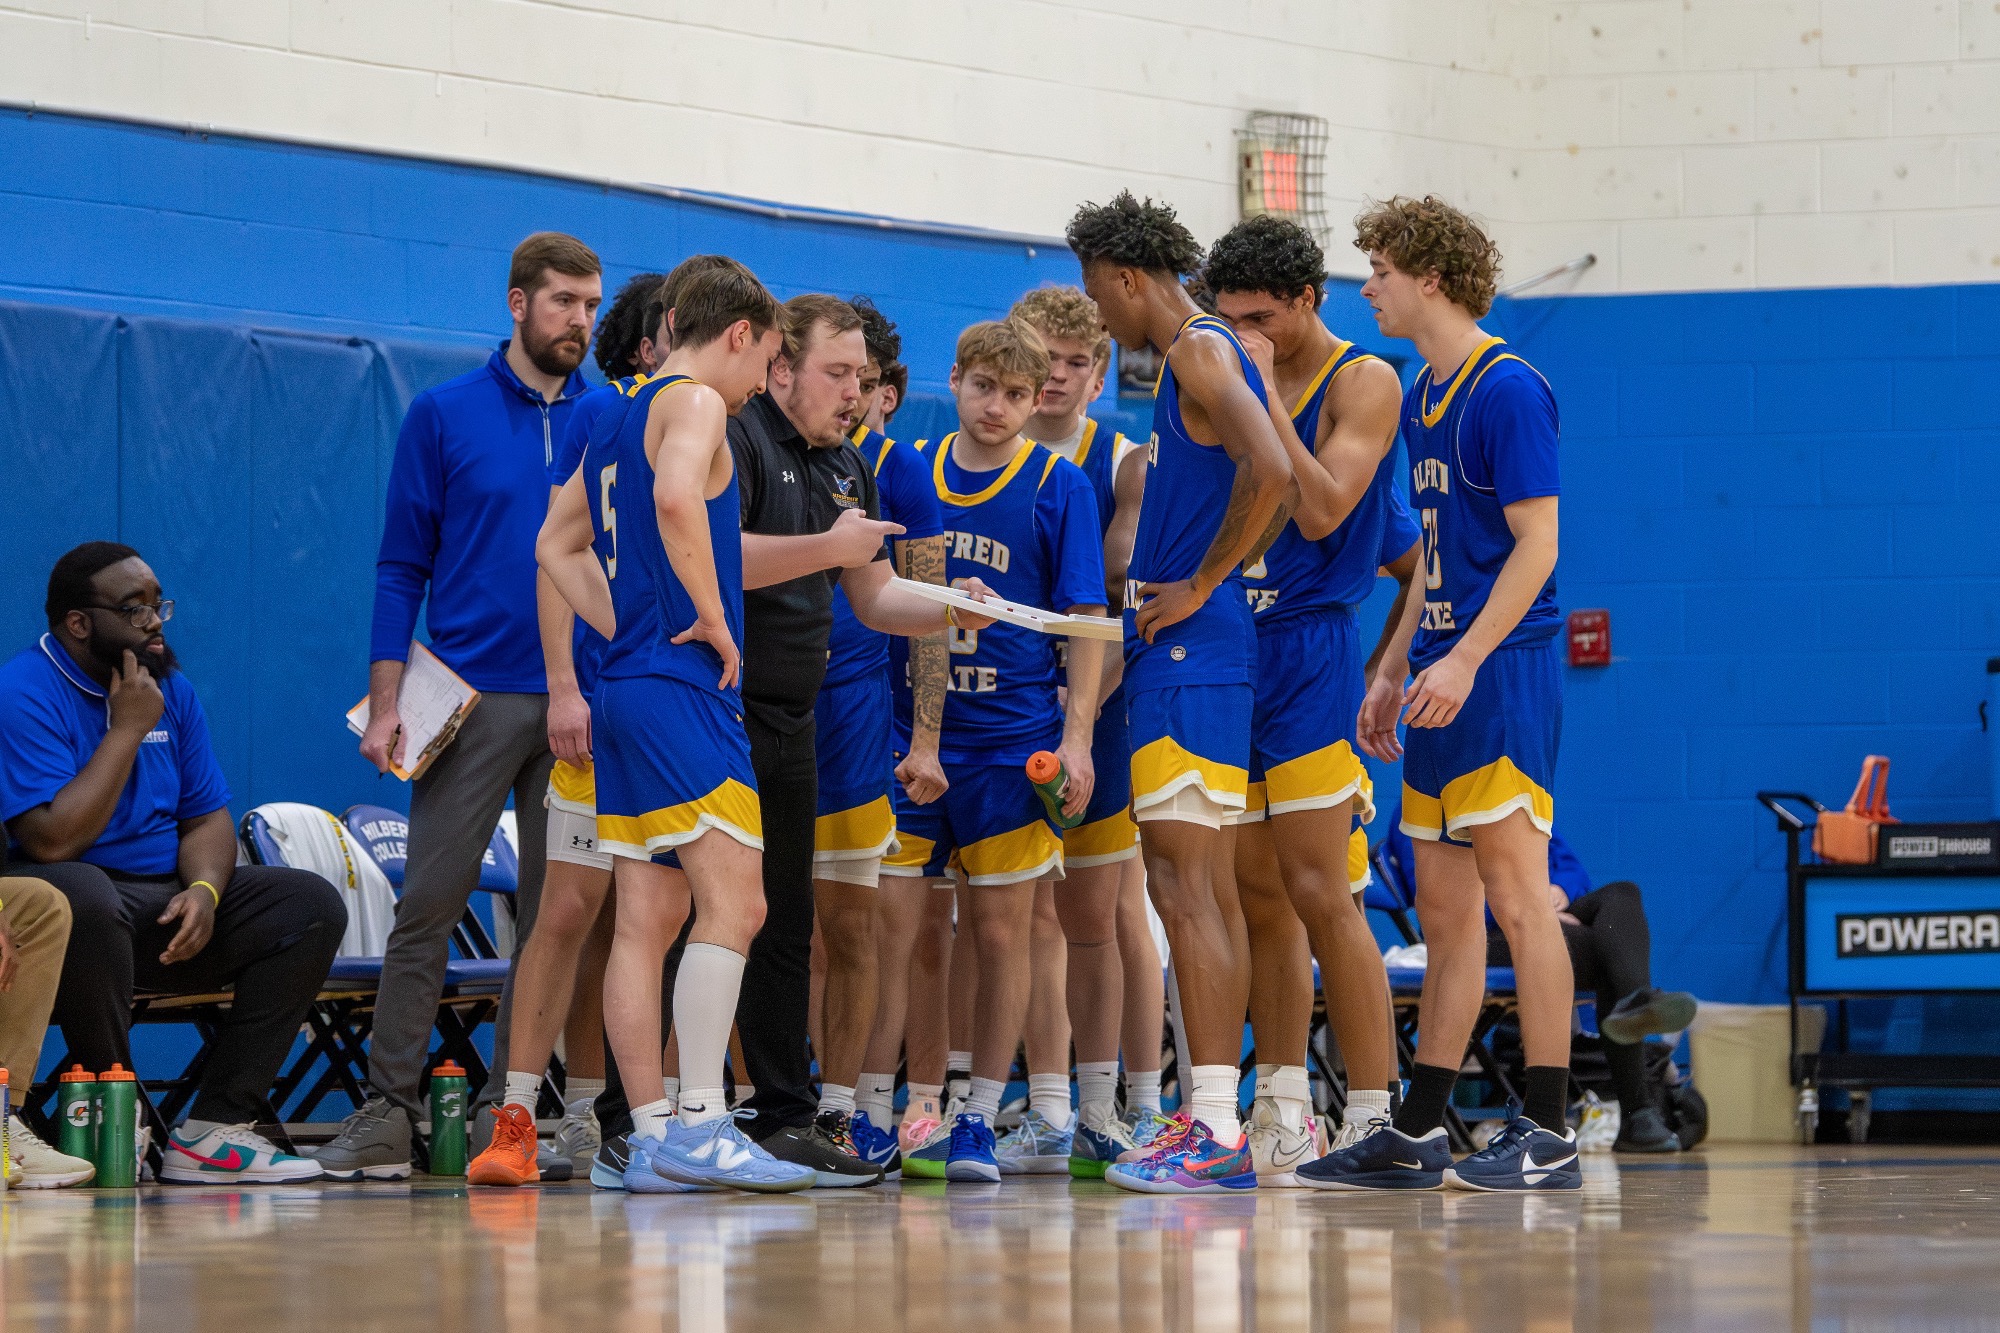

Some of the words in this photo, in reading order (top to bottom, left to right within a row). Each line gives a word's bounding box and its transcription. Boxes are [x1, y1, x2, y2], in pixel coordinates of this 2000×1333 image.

[600, 461, 617, 580] 5
[943, 530, 1010, 574] FRED
[360, 820, 409, 842] HILBER
[372, 841, 408, 863] COLLE
[66, 1100, 89, 1127] G
